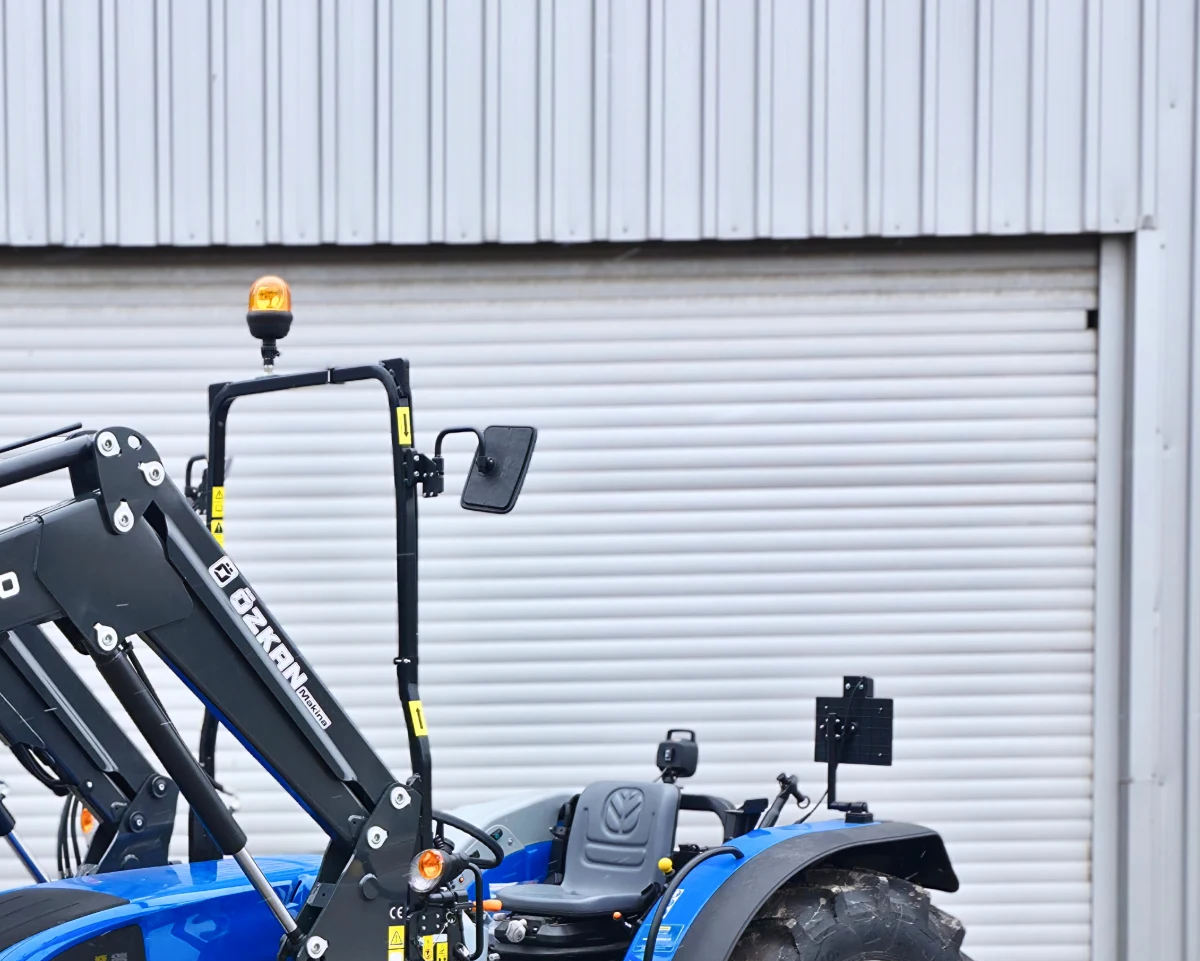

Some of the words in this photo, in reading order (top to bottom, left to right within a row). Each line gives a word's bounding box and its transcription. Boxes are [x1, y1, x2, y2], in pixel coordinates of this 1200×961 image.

[229, 586, 309, 692] ÖZKAN
[299, 688, 329, 728] Makina
[389, 906, 404, 920] CE
